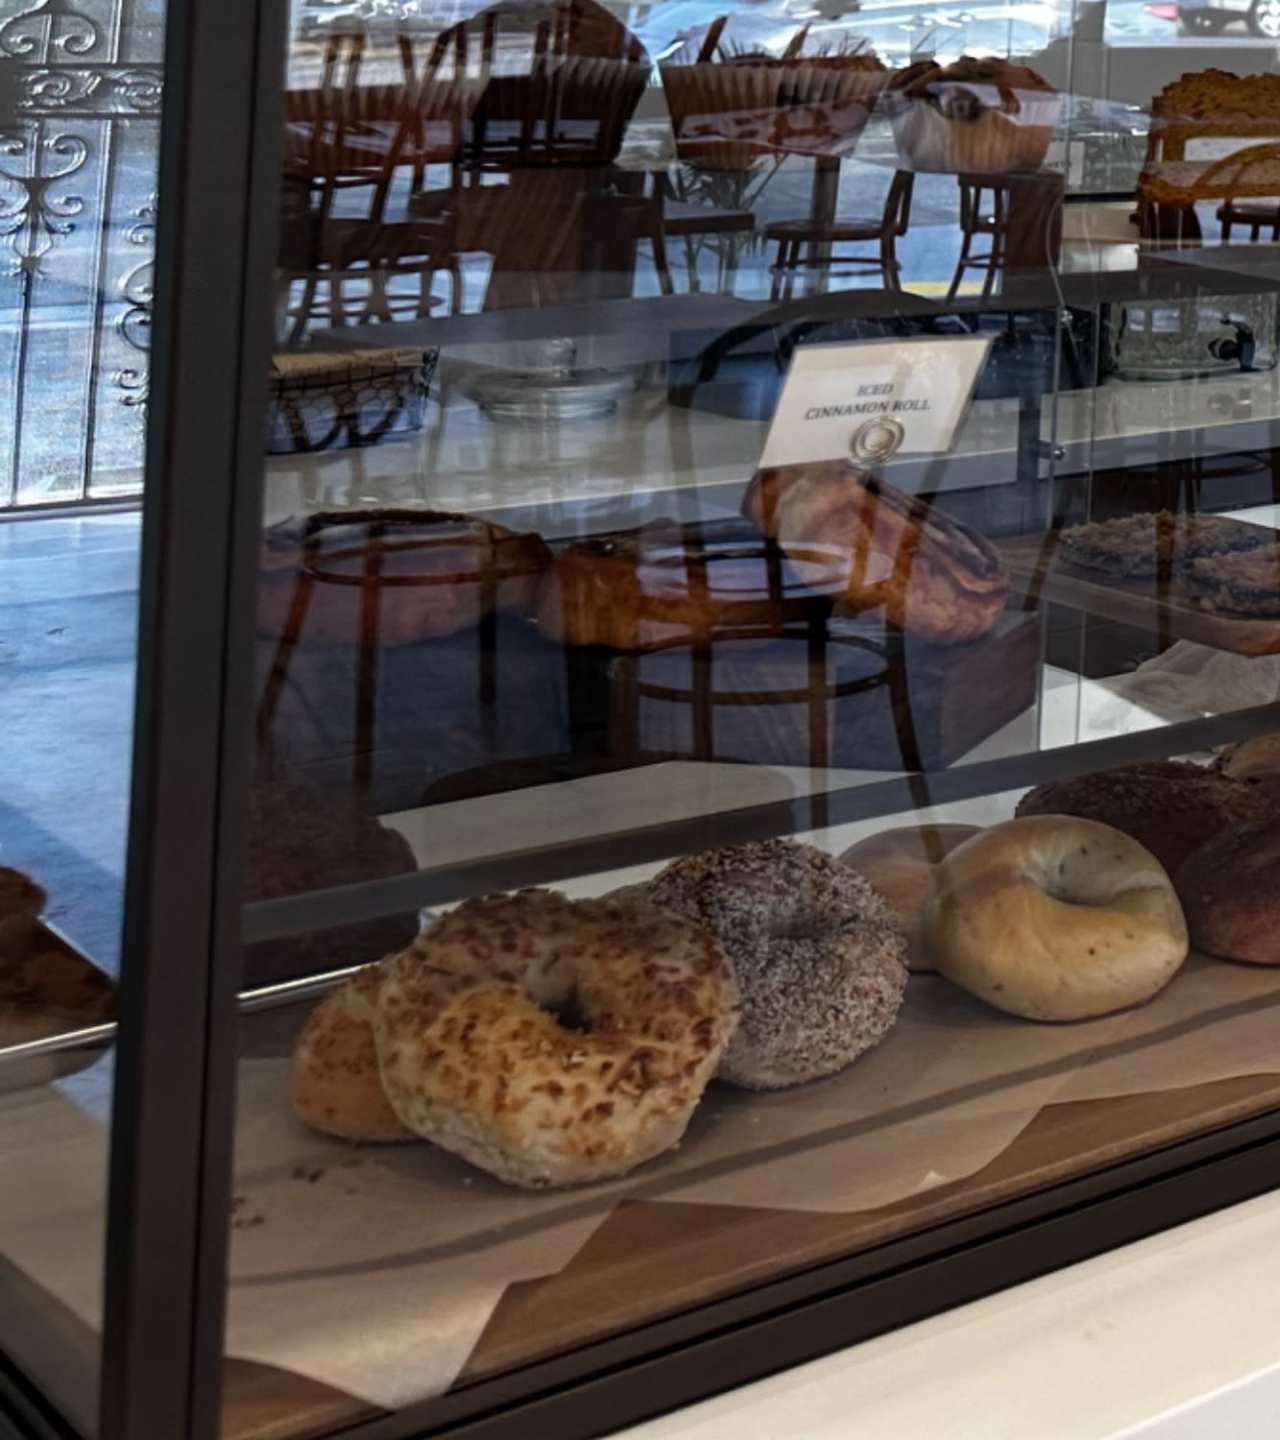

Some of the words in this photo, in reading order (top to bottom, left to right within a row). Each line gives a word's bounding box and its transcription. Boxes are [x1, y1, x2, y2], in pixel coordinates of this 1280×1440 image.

[856, 383, 895, 397] ICED
[804, 400, 894, 421] CINNAMON
[892, 399, 931, 412] ROLL
